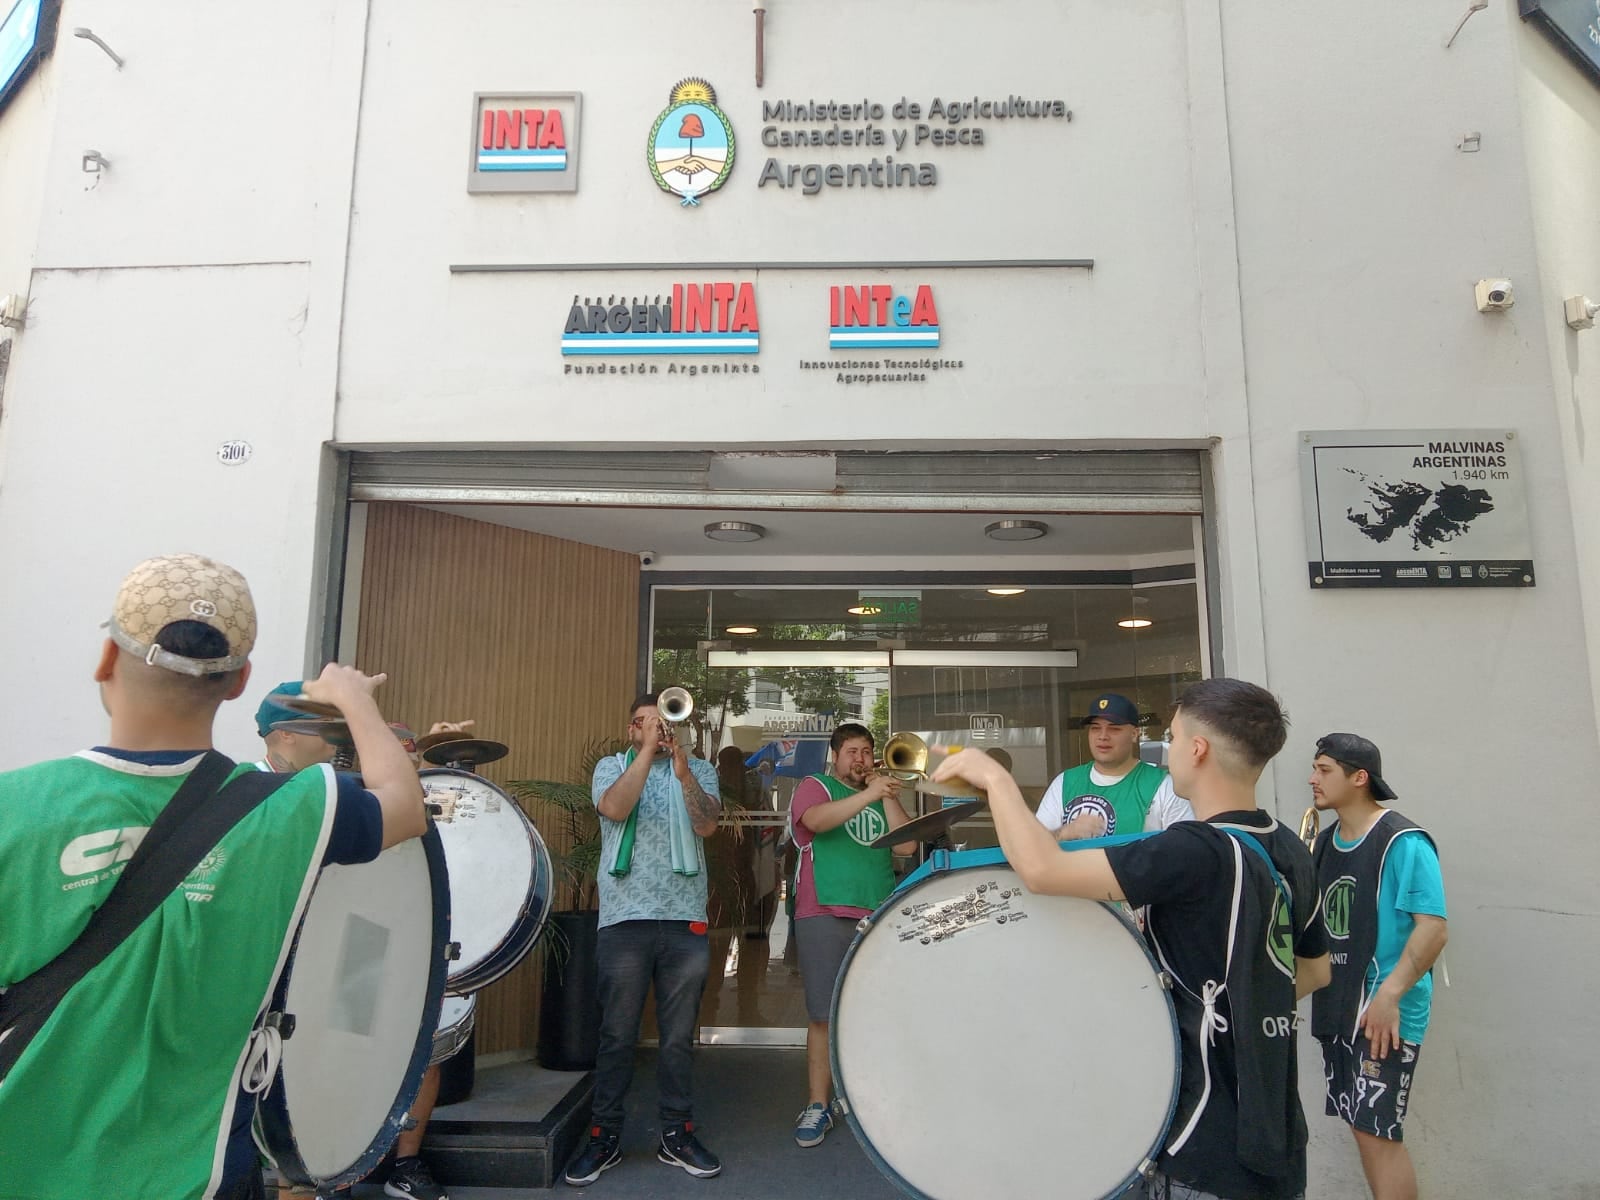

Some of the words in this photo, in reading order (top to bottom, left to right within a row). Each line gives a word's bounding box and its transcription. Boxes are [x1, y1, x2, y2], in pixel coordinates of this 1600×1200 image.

[762, 99, 884, 121] Ministerio
[892, 97, 920, 119] de
[928, 95, 1073, 123] Agricultura,
[483, 109, 566, 149] INTA
[761, 124, 885, 147] Ganadería
[892, 128, 908, 151] y
[915, 124, 985, 146] Pesca
[758, 156, 937, 195] Argentina
[564, 283, 760, 333] ARGENINTA
[830, 285, 939, 327] INTeA
[564, 363, 658, 375] Fundación
[668, 363, 760, 376] Argeninta
[800, 359, 880, 370] Innovaciones
[884, 358, 964, 371] Tecnológicas
[836, 373, 926, 385] Agropecuarias
[222, 445, 246, 460] 3101
[1428, 442, 1505, 454] MALVINAS
[1412, 456, 1507, 468] ARGENTINAS
[1452, 470, 1486, 480] 1.940
[1490, 469, 1509, 480] km
[62, 874, 99, 891] central
